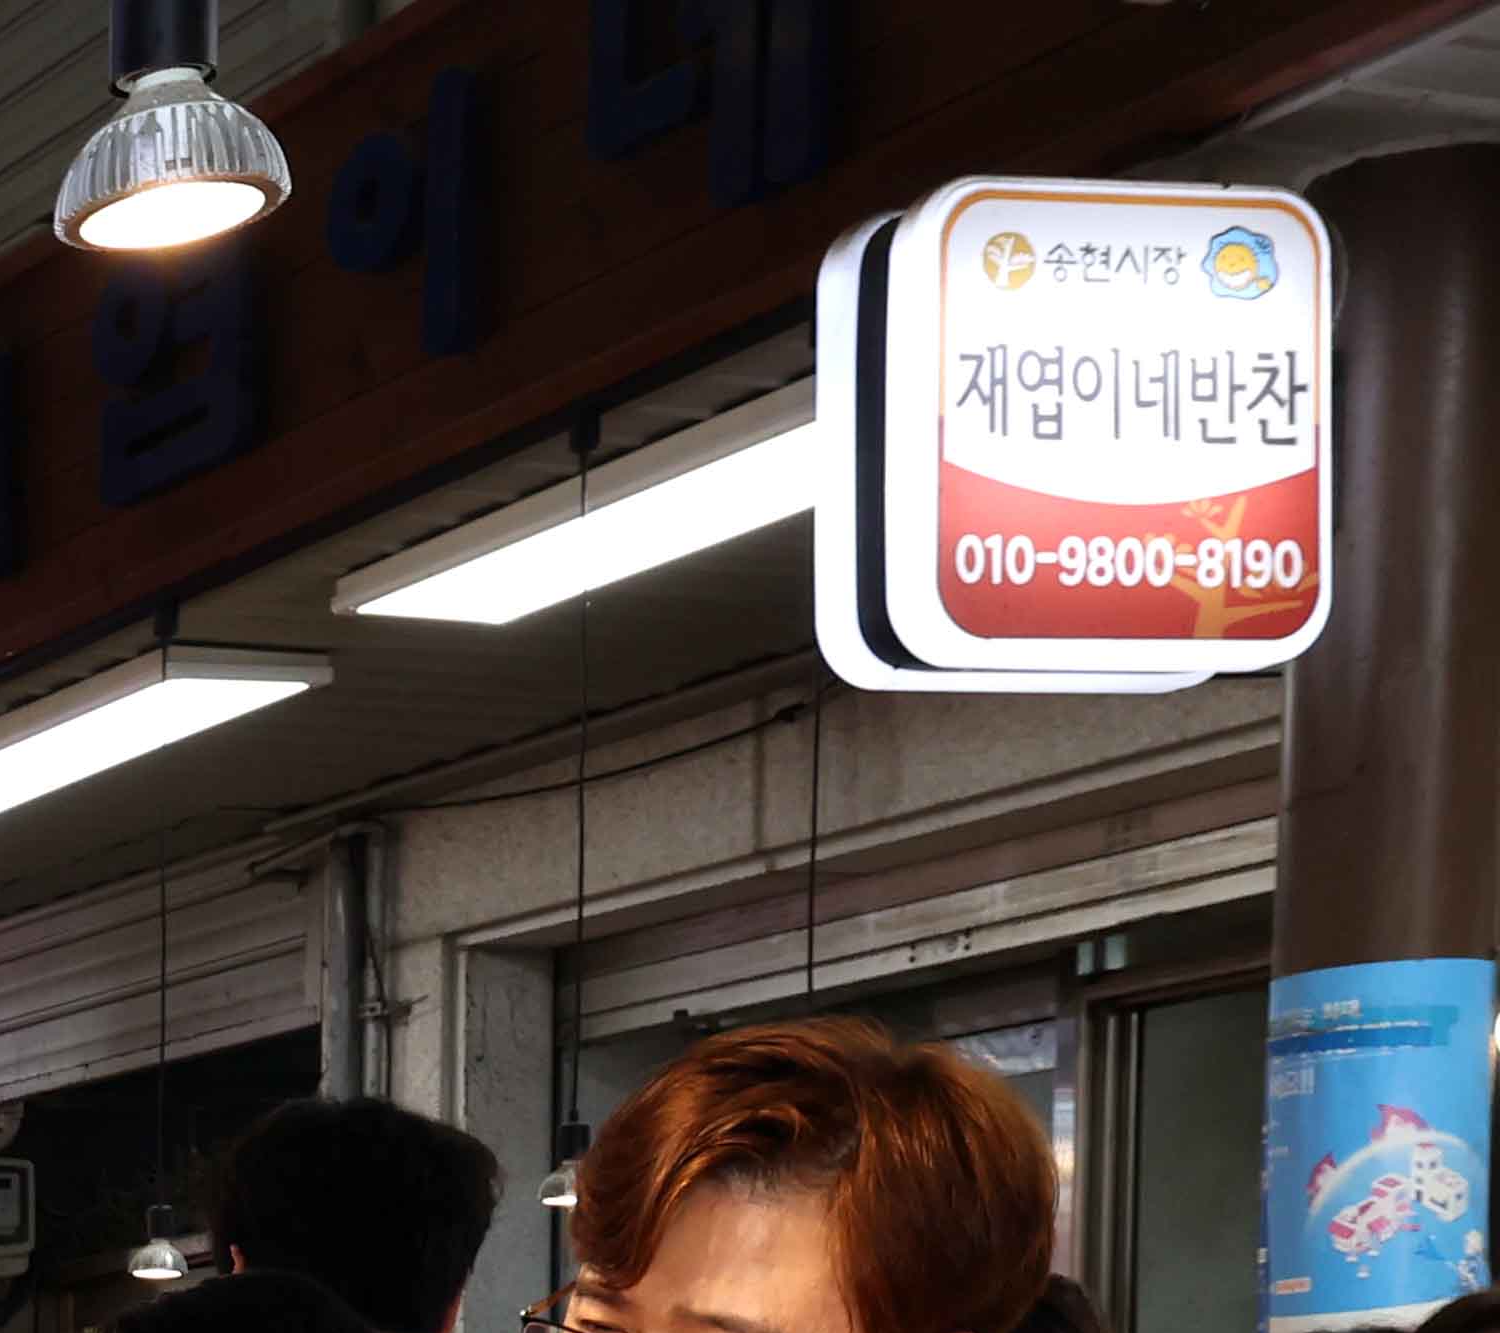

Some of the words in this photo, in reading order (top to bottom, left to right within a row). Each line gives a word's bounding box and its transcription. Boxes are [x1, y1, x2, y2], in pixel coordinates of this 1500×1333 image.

[1043, 241, 1187, 285] 송현시장
[956, 343, 1308, 446] 재엽이네반찬
[955, 534, 1303, 589] 010-9800-8190
